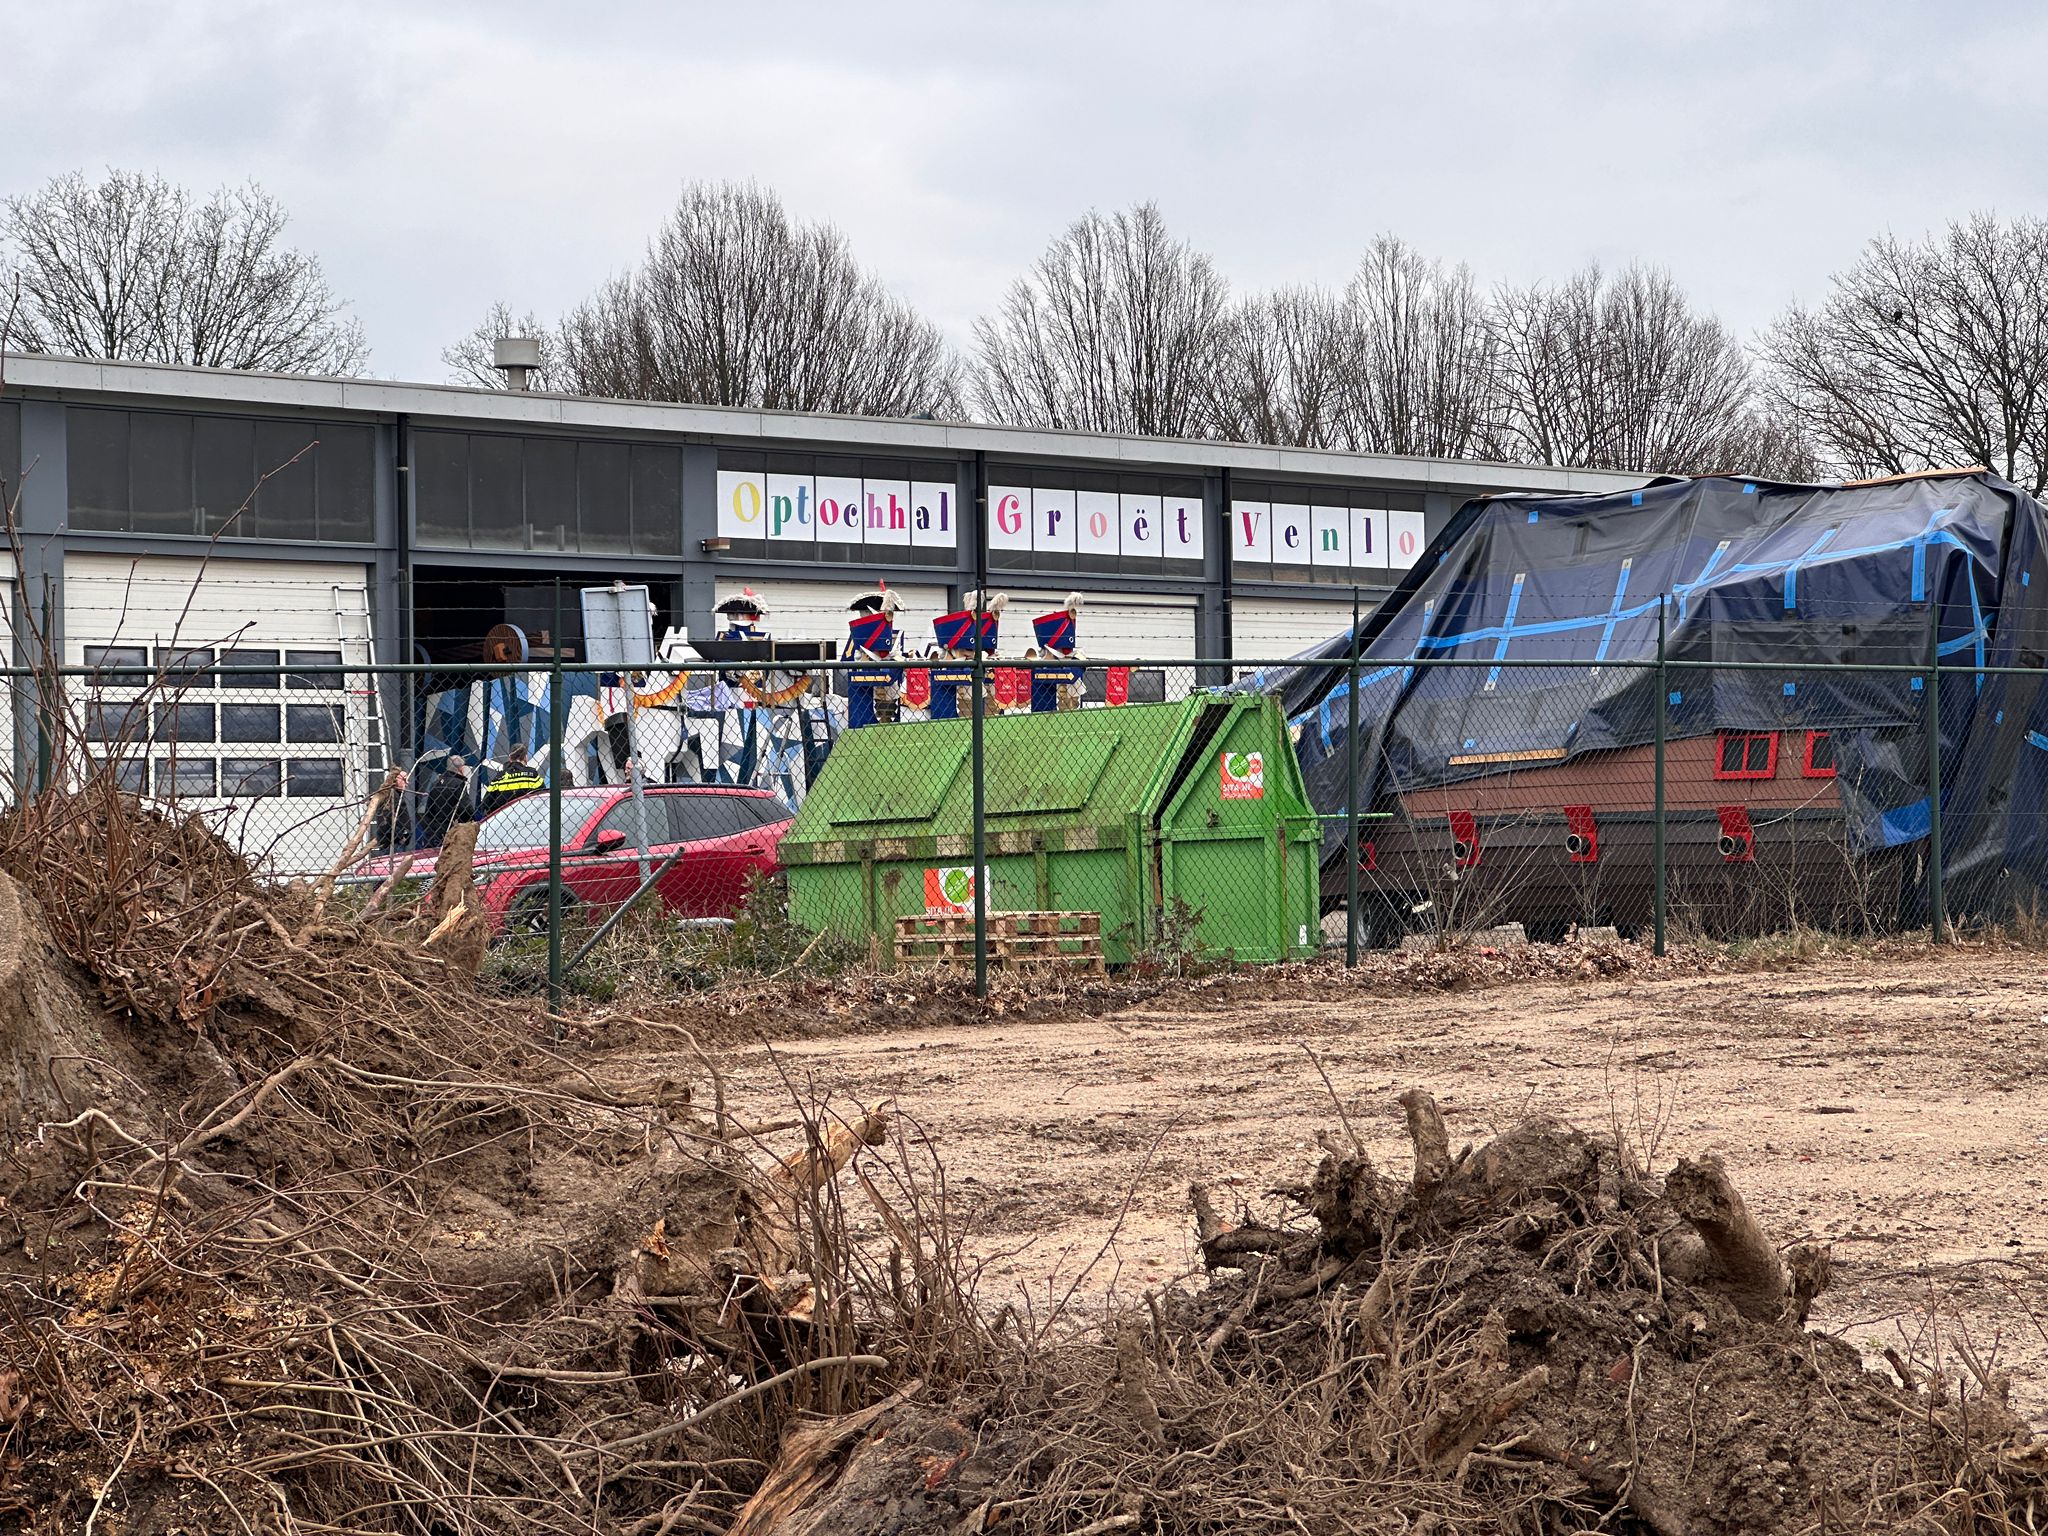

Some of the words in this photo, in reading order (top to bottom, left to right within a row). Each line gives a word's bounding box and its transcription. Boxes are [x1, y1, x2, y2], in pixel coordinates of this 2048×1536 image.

[732, 481, 949, 537] Optochhal
[997, 494, 1191, 544] Groët
[1241, 512, 1415, 555] Venlo
